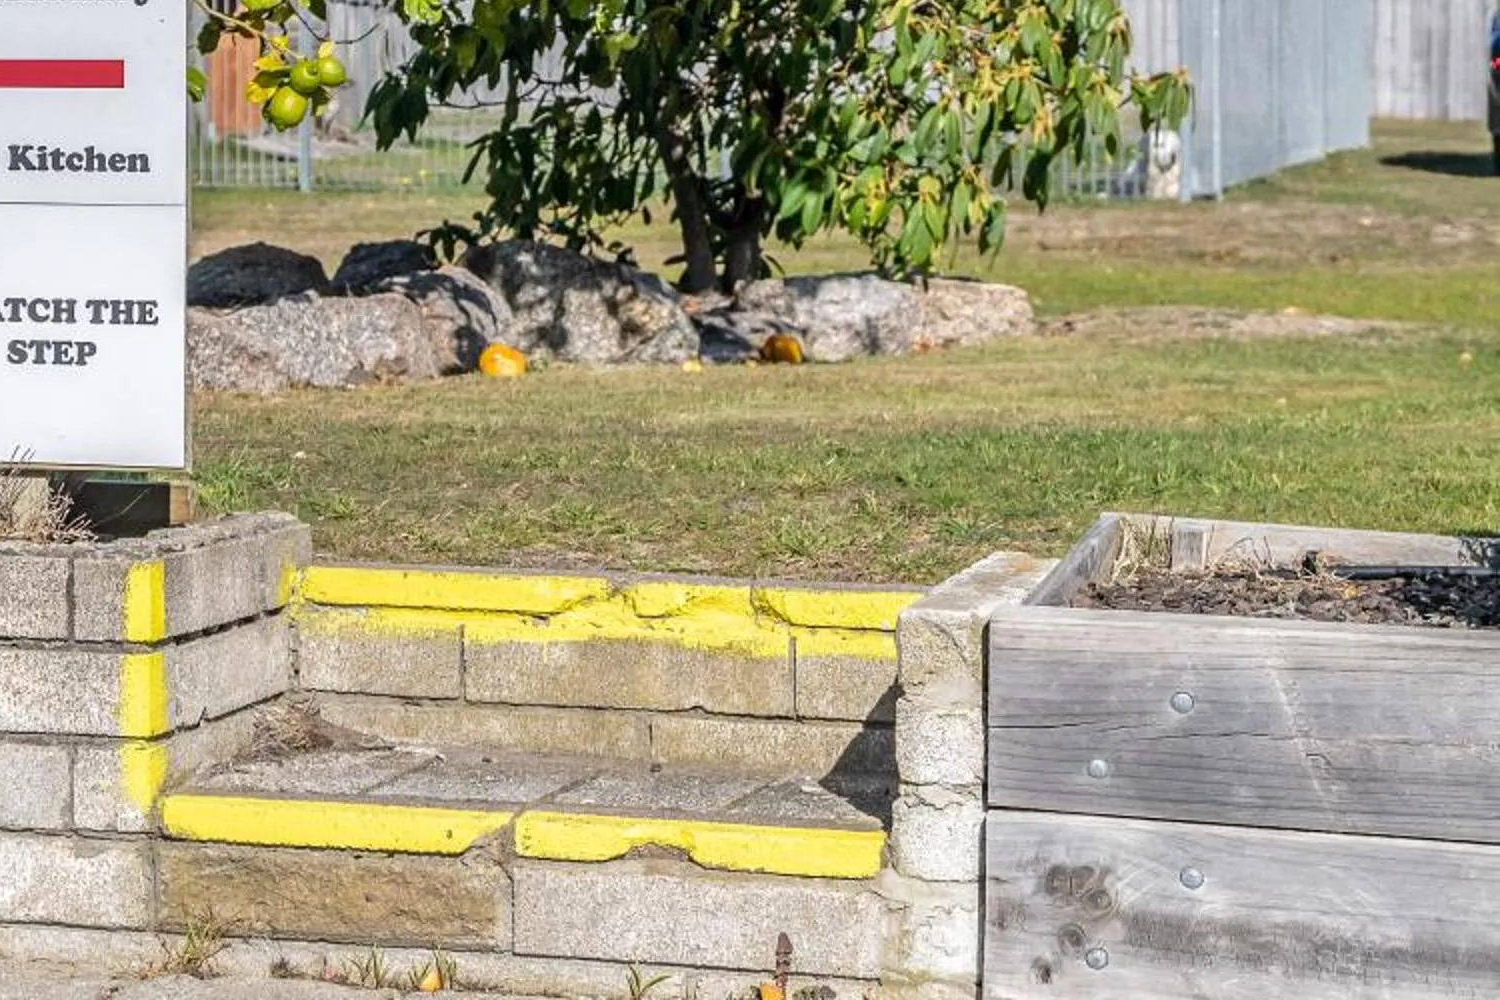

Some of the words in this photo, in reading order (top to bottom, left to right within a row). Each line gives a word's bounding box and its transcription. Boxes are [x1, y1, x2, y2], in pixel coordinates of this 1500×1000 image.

[8, 145, 150, 172] Kitchen
[86, 300, 158, 325] THE
[8, 340, 96, 366] STEP
